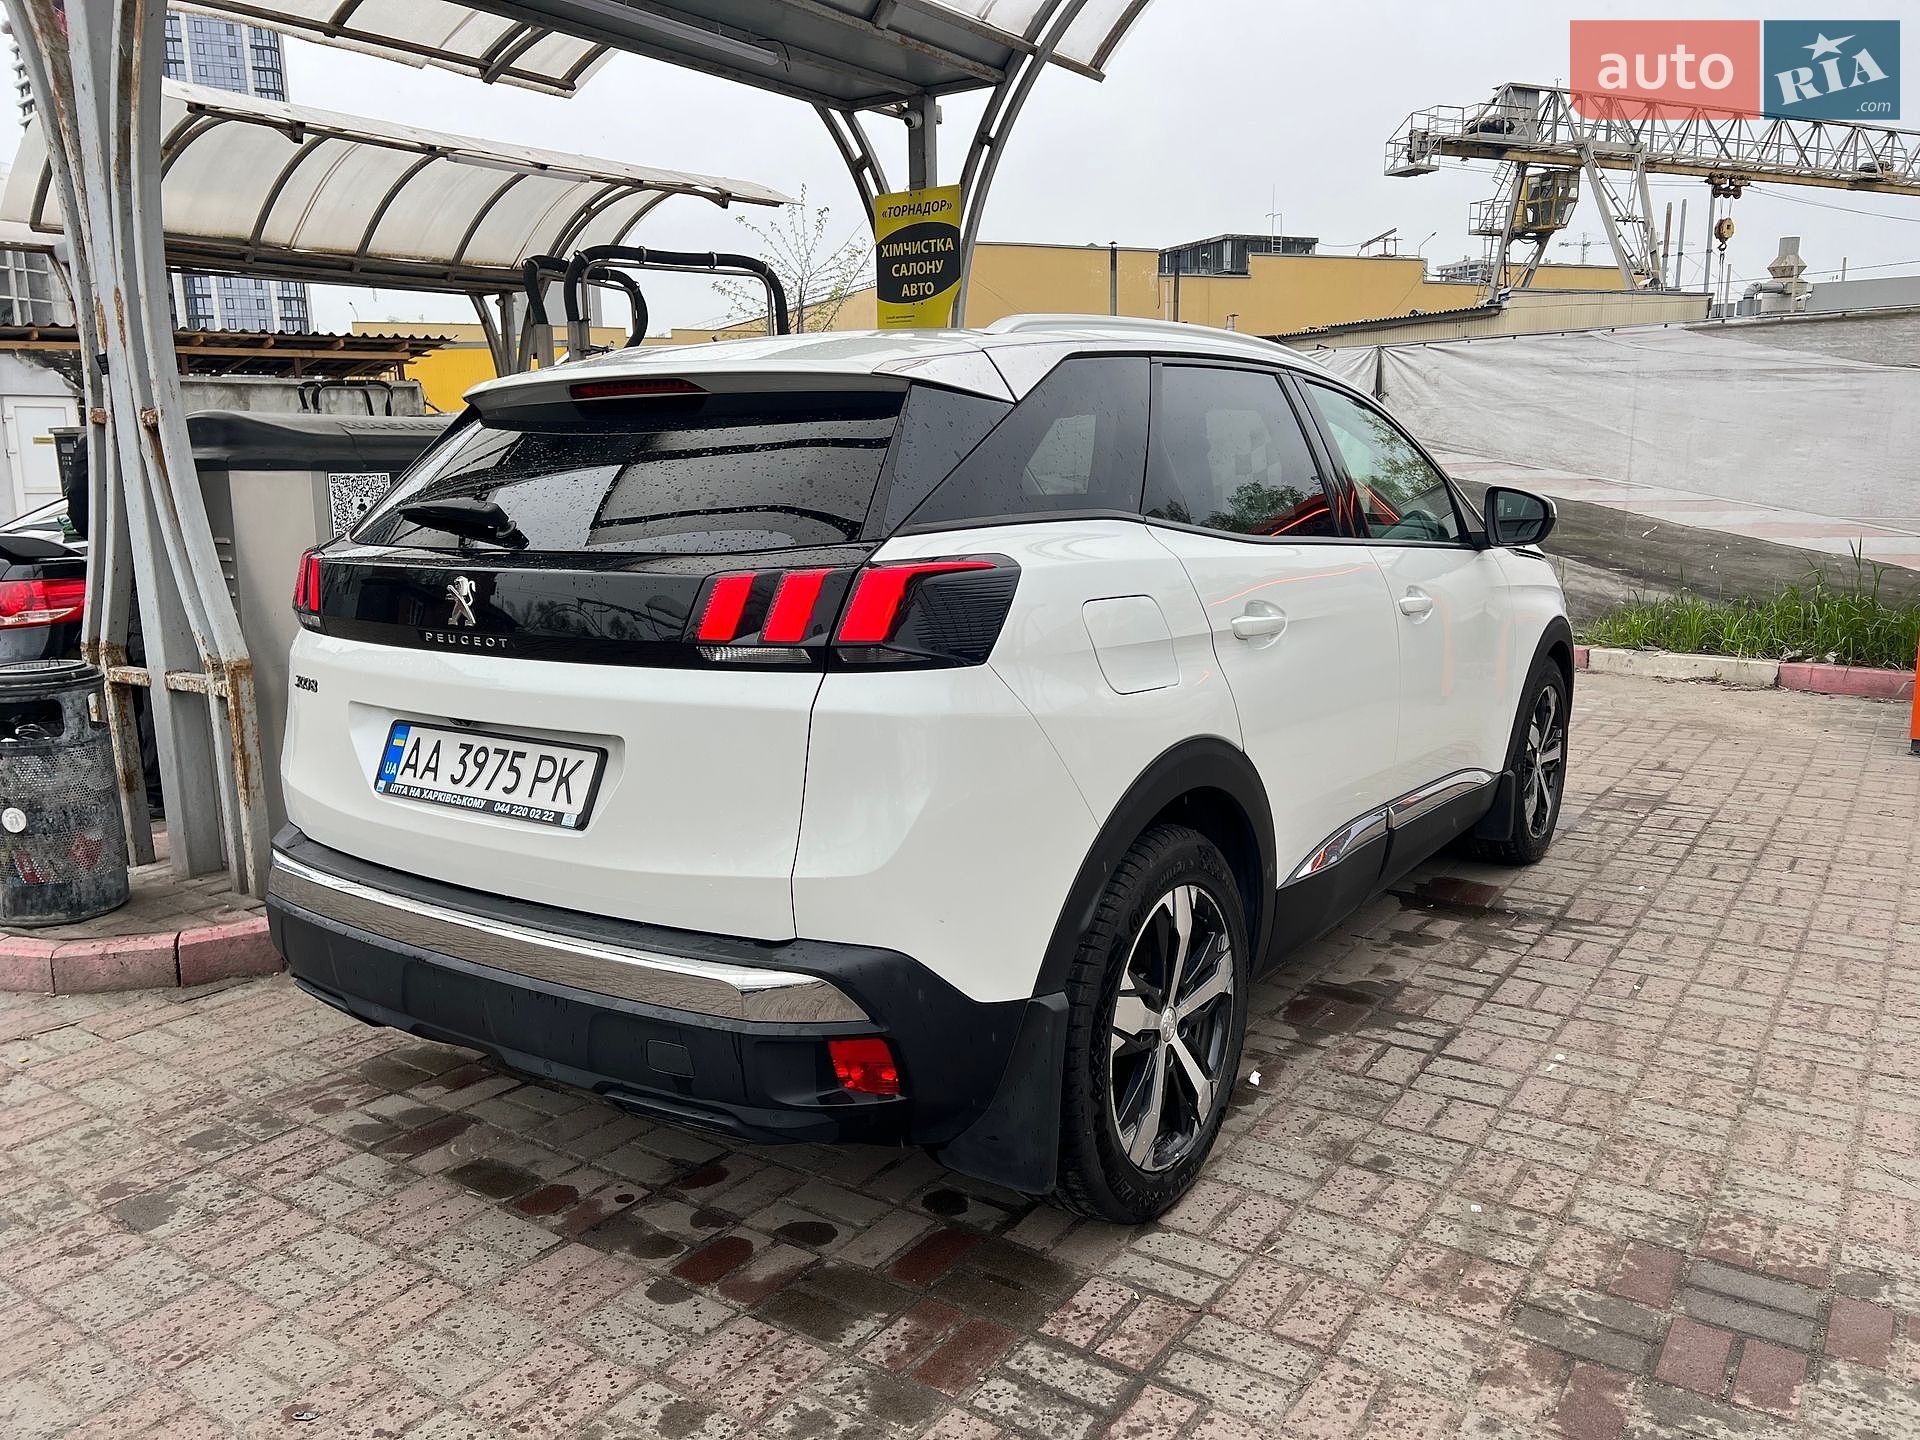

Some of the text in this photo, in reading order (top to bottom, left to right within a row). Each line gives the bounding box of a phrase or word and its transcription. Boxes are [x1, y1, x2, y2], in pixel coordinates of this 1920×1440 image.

[882, 200, 952, 218] «ТОРНАДОР»
[881, 237, 954, 258] ХІМЧИСТКА
[892, 260, 944, 277] САЛОНУ
[901, 281, 935, 297] АВТО
[425, 632, 508, 648] PEUGEOT
[384, 761, 398, 776] UA
[400, 736, 584, 805] AA 3975 PK
[409, 787, 421, 798] НА
[421, 790, 487, 809] ХАРКІВСЬКОМУ
[493, 802, 511, 814] 044
[511, 805, 528, 817] 220
[529, 808, 542, 819] 02
[542, 810, 555, 822] 22
